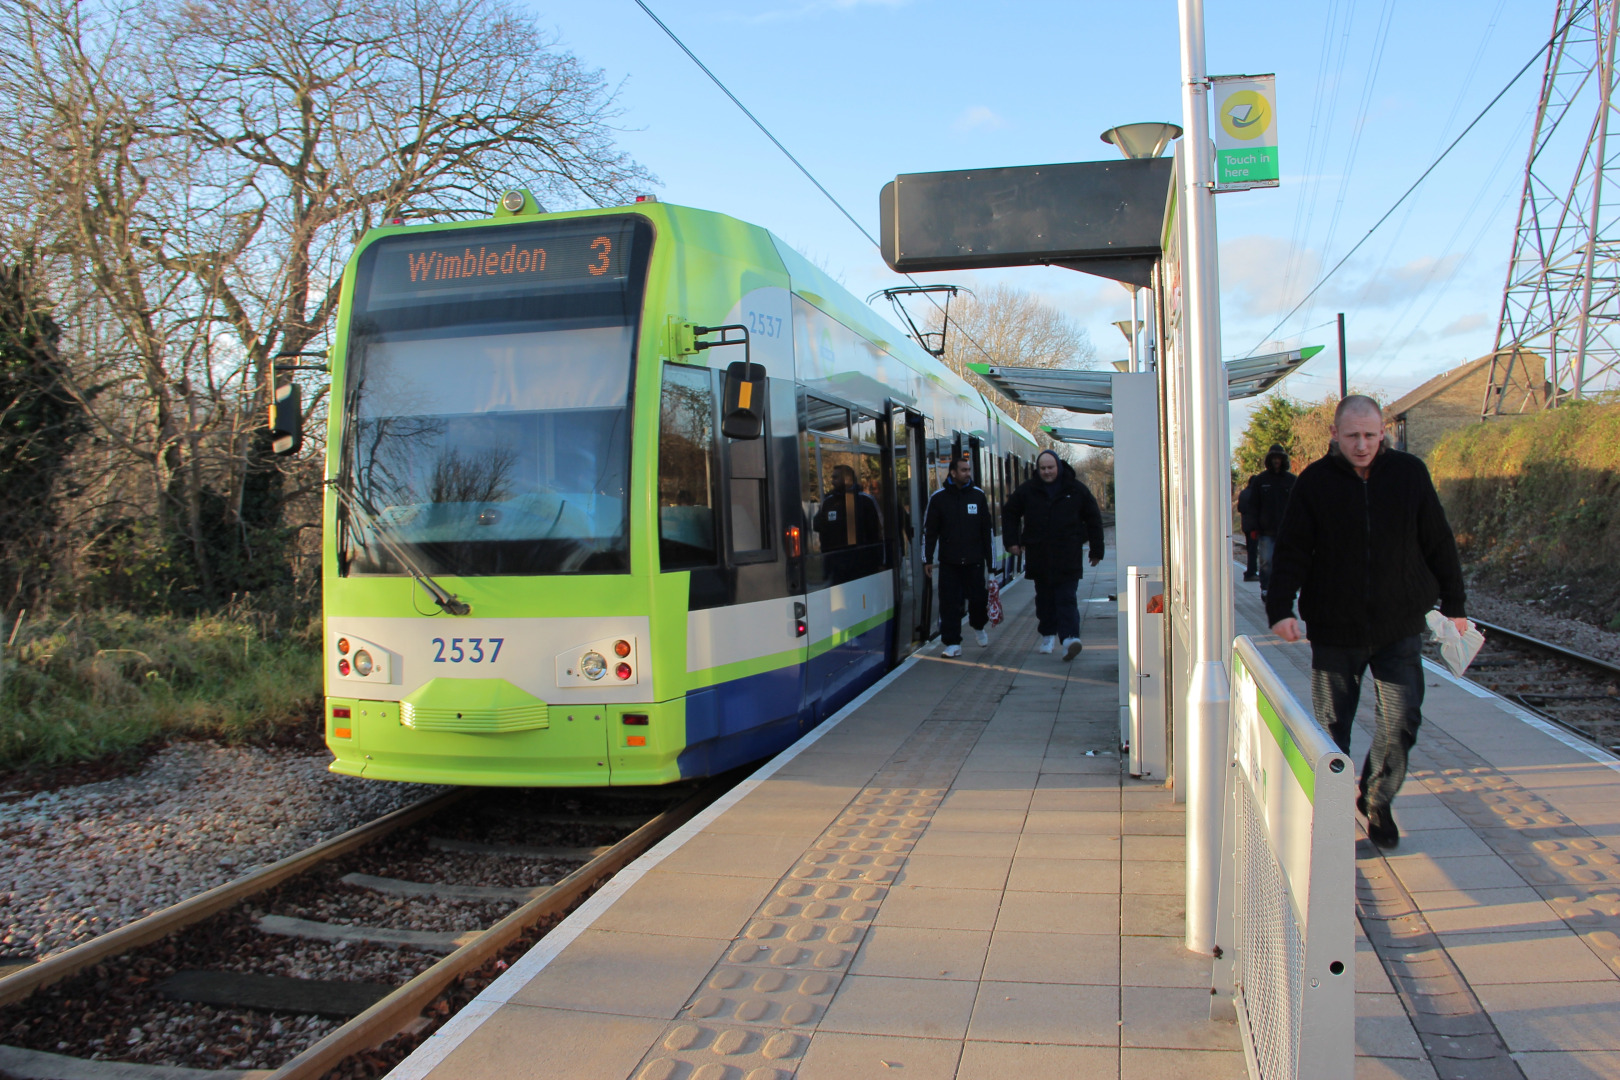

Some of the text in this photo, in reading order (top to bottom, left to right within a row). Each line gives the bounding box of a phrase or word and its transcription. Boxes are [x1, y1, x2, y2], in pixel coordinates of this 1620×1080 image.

[1224, 153, 1271, 165] Touch in
[1224, 168, 1249, 177] here
[408, 236, 612, 282] Wimbledon 3
[748, 311, 783, 339] 2537
[432, 637, 505, 663] 2537
